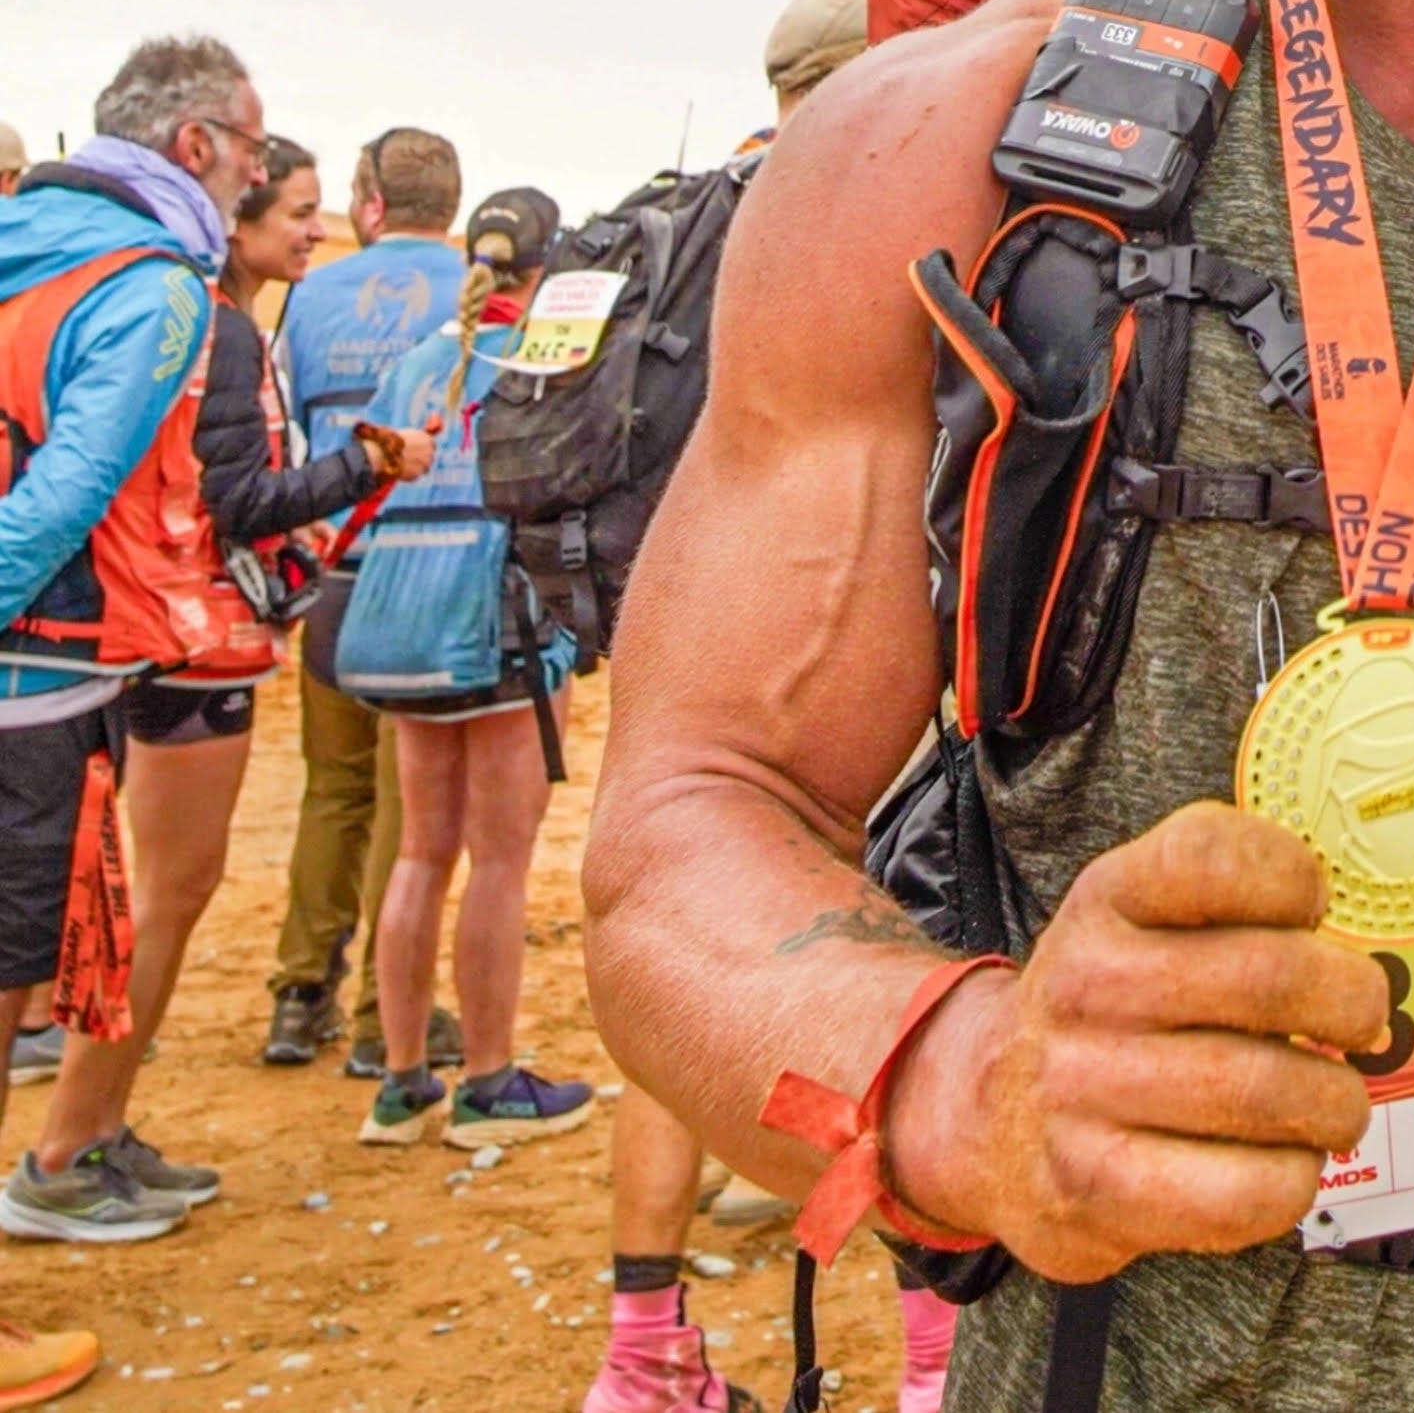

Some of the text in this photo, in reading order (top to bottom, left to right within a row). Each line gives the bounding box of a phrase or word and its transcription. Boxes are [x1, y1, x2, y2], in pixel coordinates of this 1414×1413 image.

[1104, 24, 1134, 45] 333
[1040, 109, 1112, 138] OWAKA
[1316, 342, 1332, 401] DES SABLES
[1327, 341, 1345, 401] MARATHON
[1318, 1165, 1378, 1190] MDS
